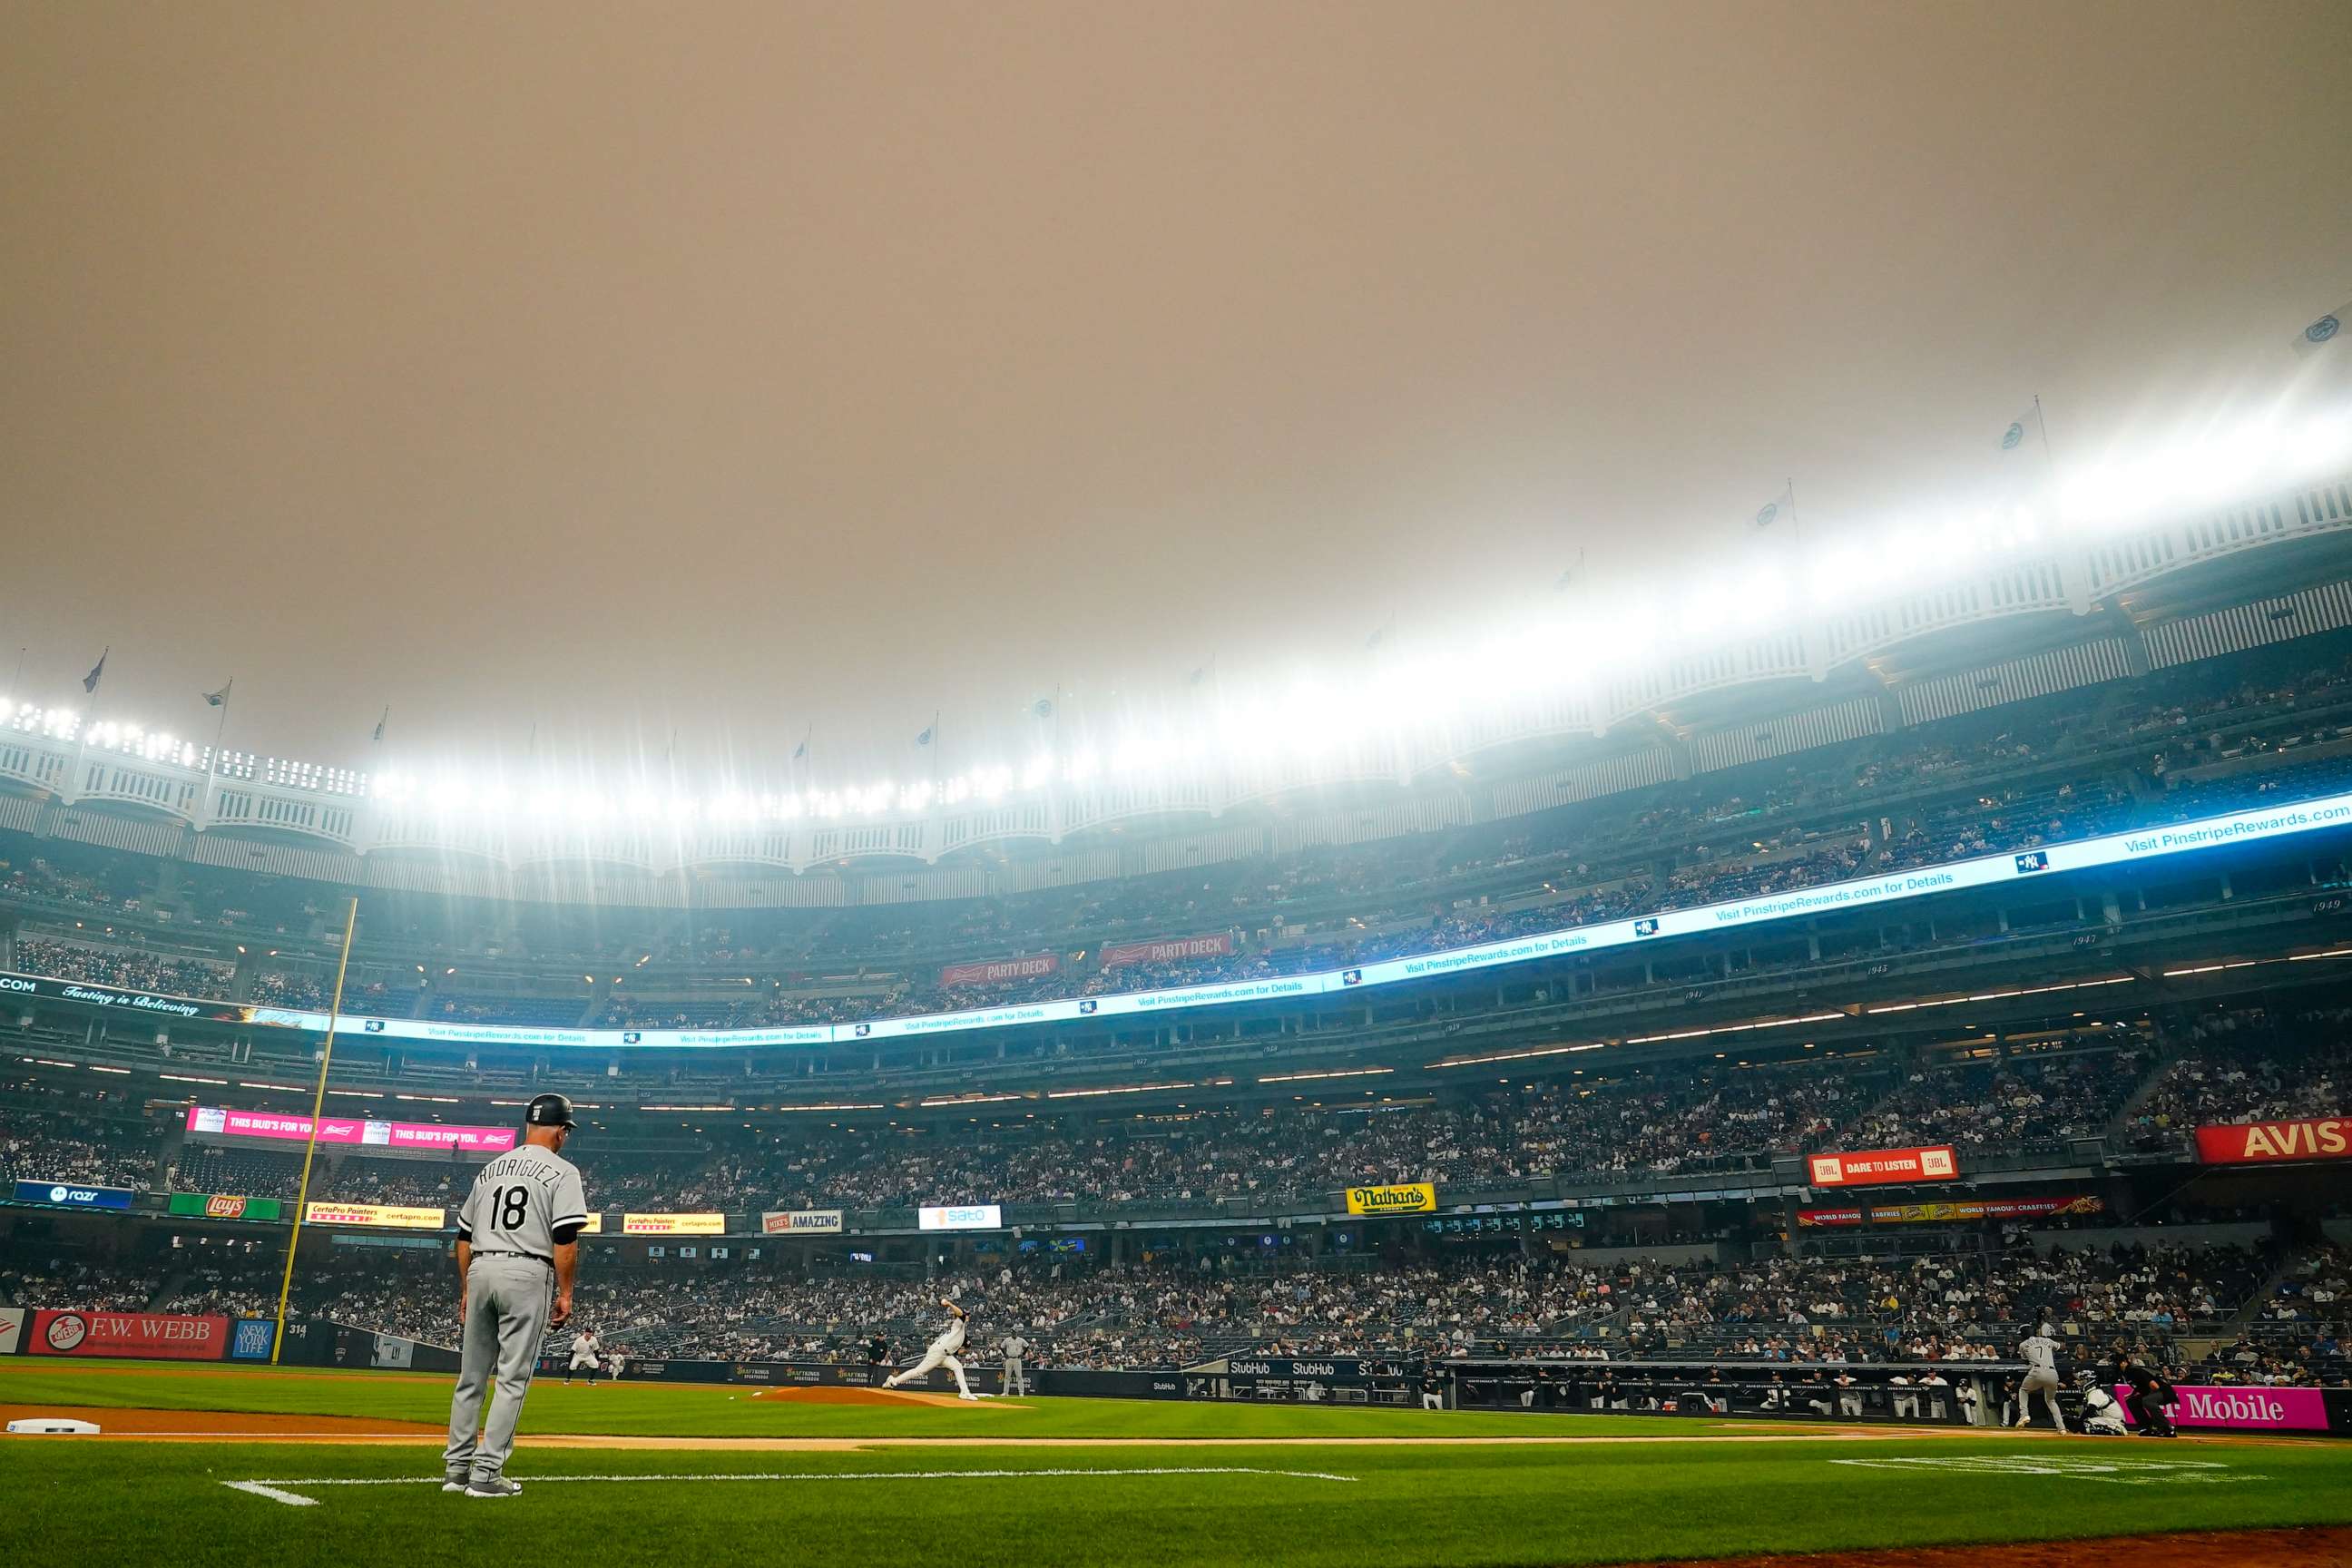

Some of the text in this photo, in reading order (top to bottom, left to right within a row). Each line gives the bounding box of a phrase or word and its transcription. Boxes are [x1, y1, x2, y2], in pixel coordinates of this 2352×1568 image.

[2125, 806, 2351, 853] Visit PinstripeRewards.com
[1716, 873, 1953, 921] Visit PinstripeRewards.com for Details
[1152, 944, 1190, 959] PARTY
[1191, 937, 1222, 954] DECK
[1406, 936, 1587, 974] Visit PinstripeRewards.com for Details
[987, 962, 1020, 980] PARTY
[1022, 958, 1050, 974] DECK
[63, 985, 199, 1016] Tasting is Believing
[1138, 982, 1302, 1006] Visit PinstripeRewards.com for Details
[1017, 1009, 1044, 1018] Details
[230, 1117, 250, 1128] THIS
[252, 1119, 279, 1130] BUD'S
[280, 1121, 297, 1131] FOR
[395, 1130, 415, 1139] THIS
[416, 1131, 441, 1142] BUD'S
[443, 1132, 459, 1142] FOR
[461, 1133, 479, 1143] YOU.
[2243, 1122, 2347, 1157] AVIS
[1820, 1156, 1946, 1176] JBL DARE TO LISTEN JBL
[479, 1159, 560, 1188] RODRIGUEZ
[68, 1191, 98, 1202] razr
[1354, 1187, 1426, 1207] Nathan's
[313, 1205, 377, 1215] CertaPro Painters
[490, 1183, 531, 1231] 18
[386, 1212, 441, 1221] certapro.com
[792, 1215, 839, 1228] AMAZING
[948, 1209, 985, 1221] sato
[769, 1219, 789, 1230] MIKE'S
[55, 1325, 82, 1342] WEBB
[89, 1318, 211, 1340] F.W. WEBB
[242, 1325, 268, 1336] NEW
[289, 1325, 307, 1334] 314
[239, 1334, 269, 1345] YORK
[240, 1343, 263, 1353] LIFE
[2034, 1346, 2043, 1358] 7
[1230, 1362, 1270, 1375] StubHub
[1292, 1362, 1334, 1376] StubHub
[1153, 1382, 1176, 1390] StubHub
[2186, 1394, 2284, 1421] Mobile
